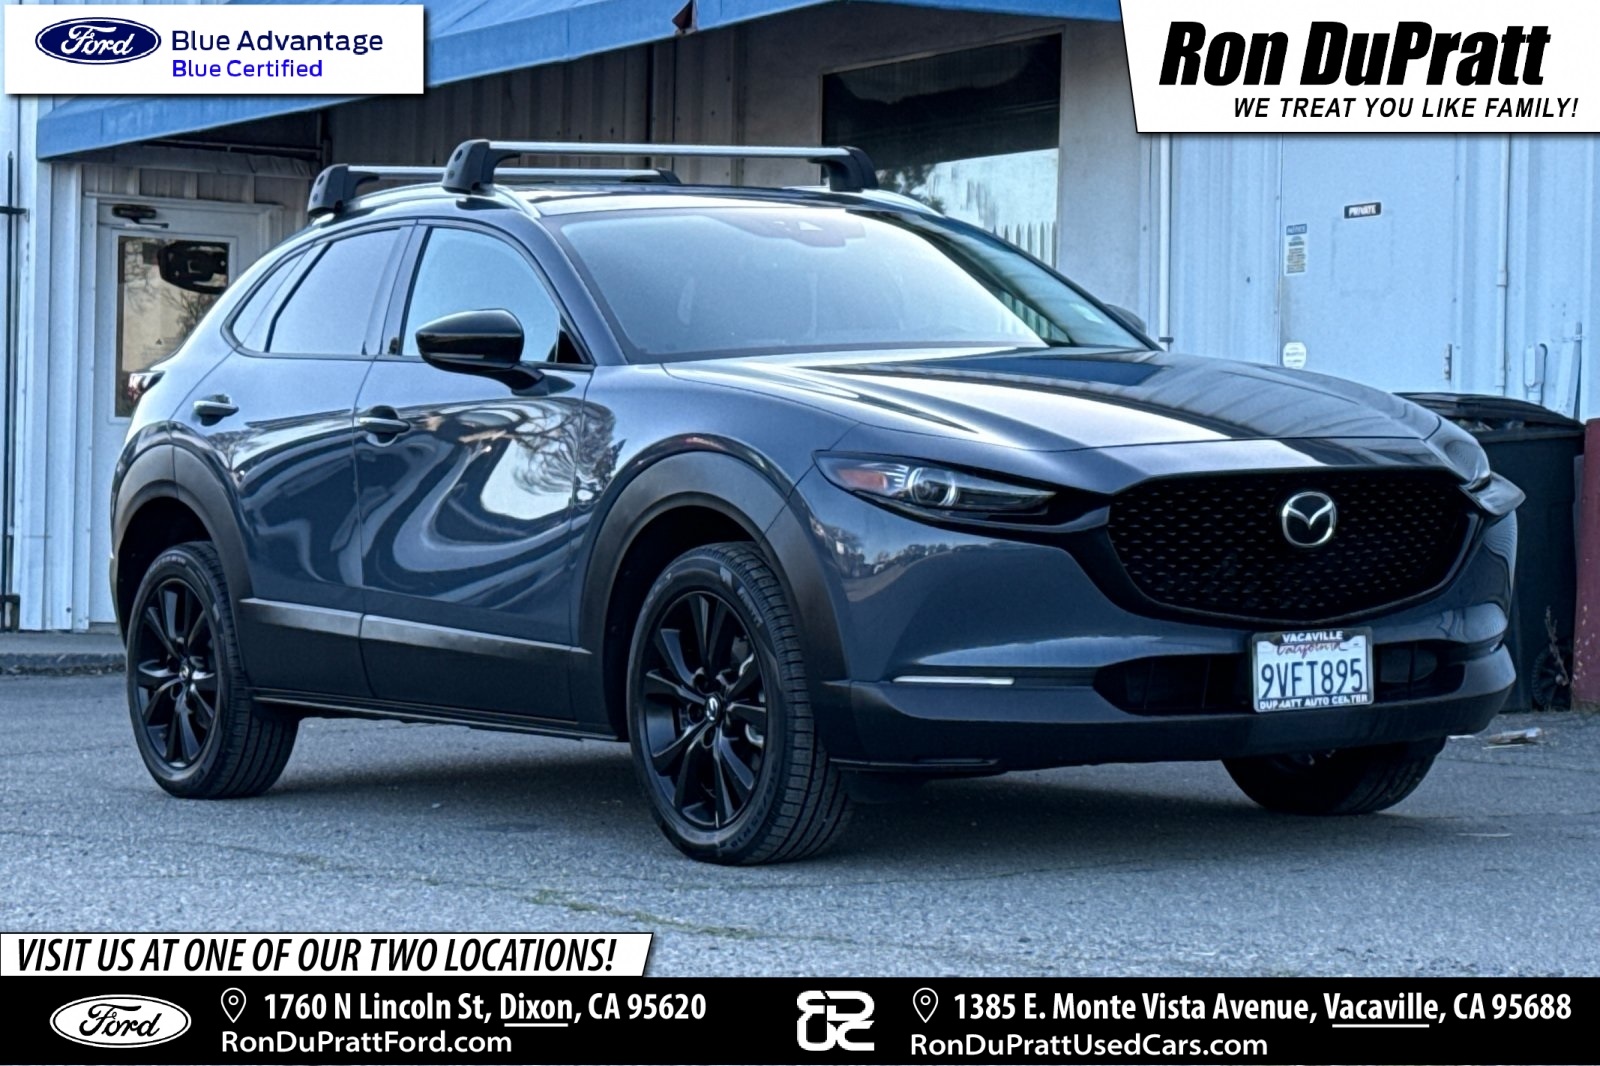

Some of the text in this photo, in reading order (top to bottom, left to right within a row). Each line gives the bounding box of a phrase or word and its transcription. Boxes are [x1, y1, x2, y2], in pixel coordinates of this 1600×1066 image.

[1282, 631, 1344, 643] VACAVILLE
[1261, 658, 1363, 699] 9VFT895
[1304, 696, 1330, 707] AUTO
